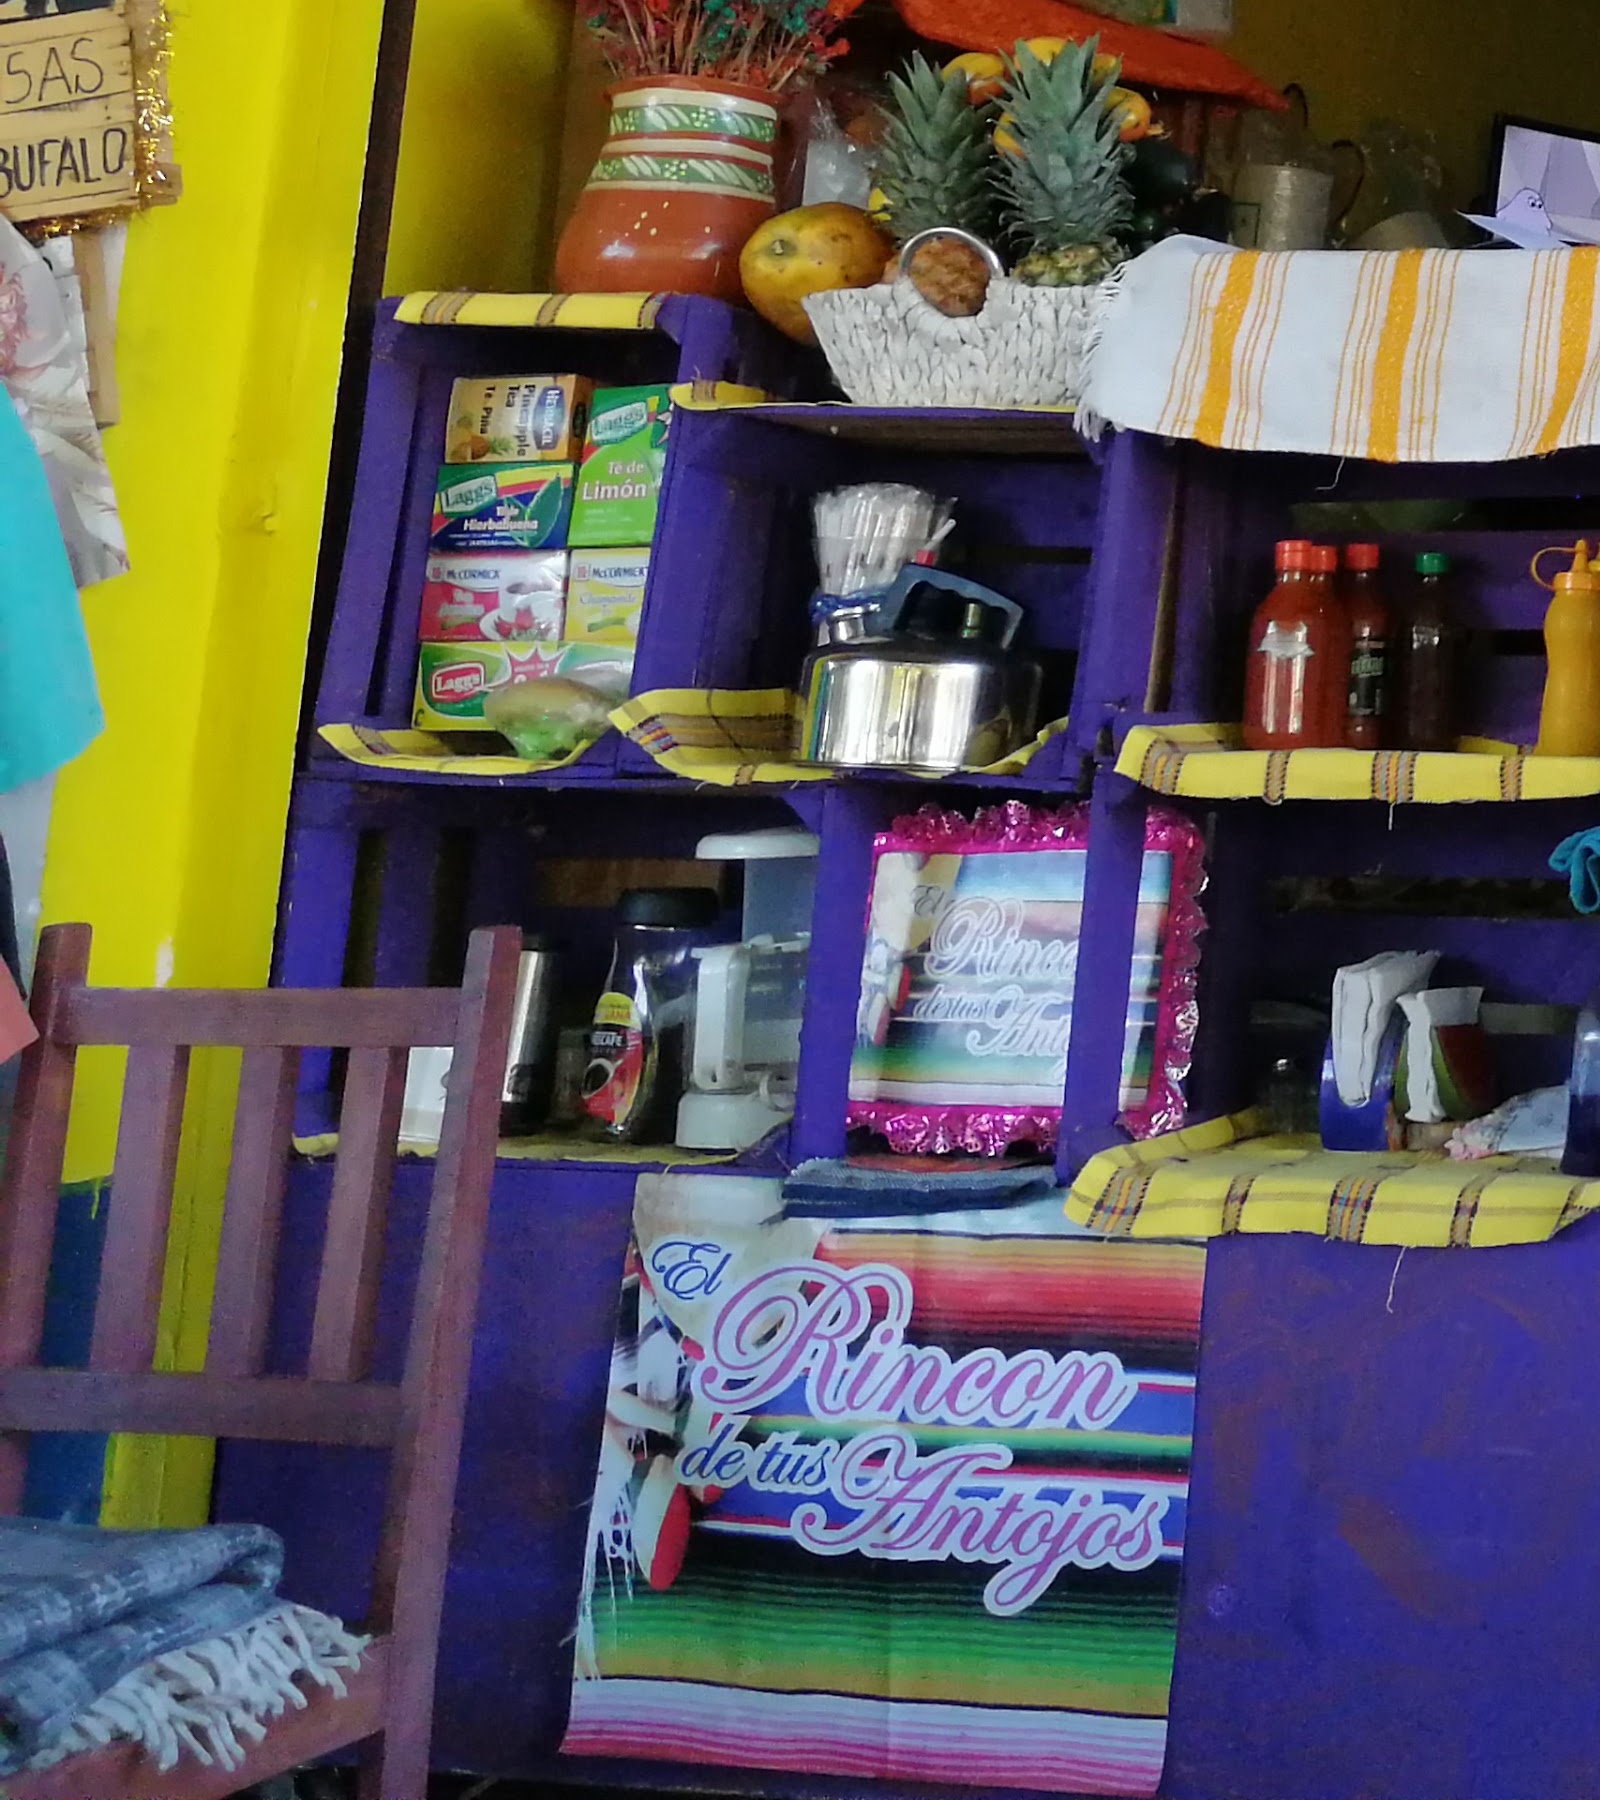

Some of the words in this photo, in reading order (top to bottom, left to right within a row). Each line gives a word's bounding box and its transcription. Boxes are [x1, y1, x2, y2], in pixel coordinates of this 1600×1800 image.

[582, 478, 648, 501] Limón
[435, 672, 481, 693] Laggs
[925, 896, 1079, 982] Rinco
[652, 1242, 730, 1299] El
[694, 1261, 1136, 1427] Rincon
[680, 1424, 746, 1485] de
[754, 1440, 835, 1490] tus
[795, 1429, 1168, 1614] Antojos
